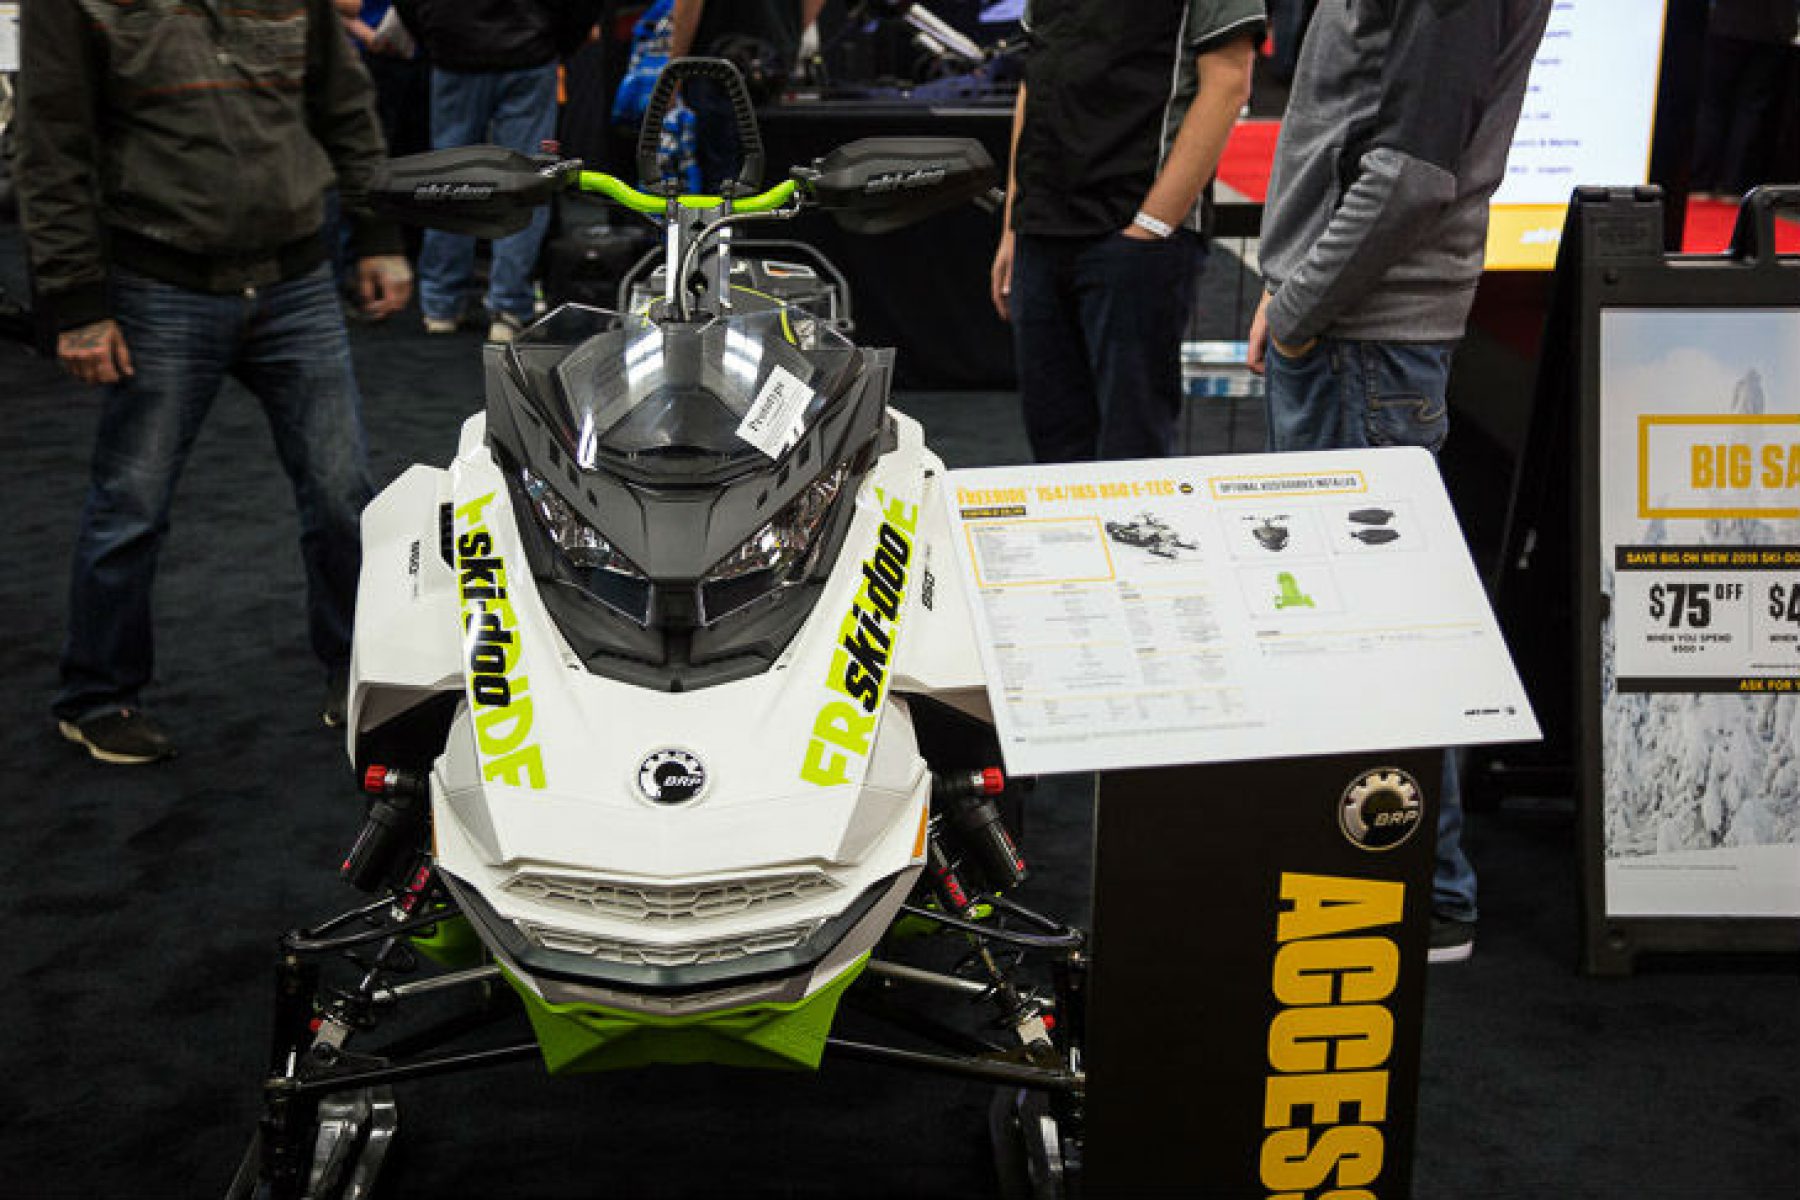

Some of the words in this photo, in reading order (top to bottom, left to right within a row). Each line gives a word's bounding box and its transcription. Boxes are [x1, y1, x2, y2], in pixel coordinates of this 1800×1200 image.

[1691, 443, 1752, 489] BIG
[1626, 551, 1658, 564] SAVE
[458, 531, 513, 708] ski-doo
[844, 521, 910, 713] ski-doo
[1648, 581, 1711, 629] $75
[1714, 583, 1744, 600] OFF
[1646, 633, 1675, 642] WHEN
[1677, 633, 1697, 642] YOU
[1700, 633, 1732, 642] SPEND
[662, 775, 702, 787] BRP
[1375, 810, 1419, 827] BRP
[1259, 871, 1406, 1200] ACCES
